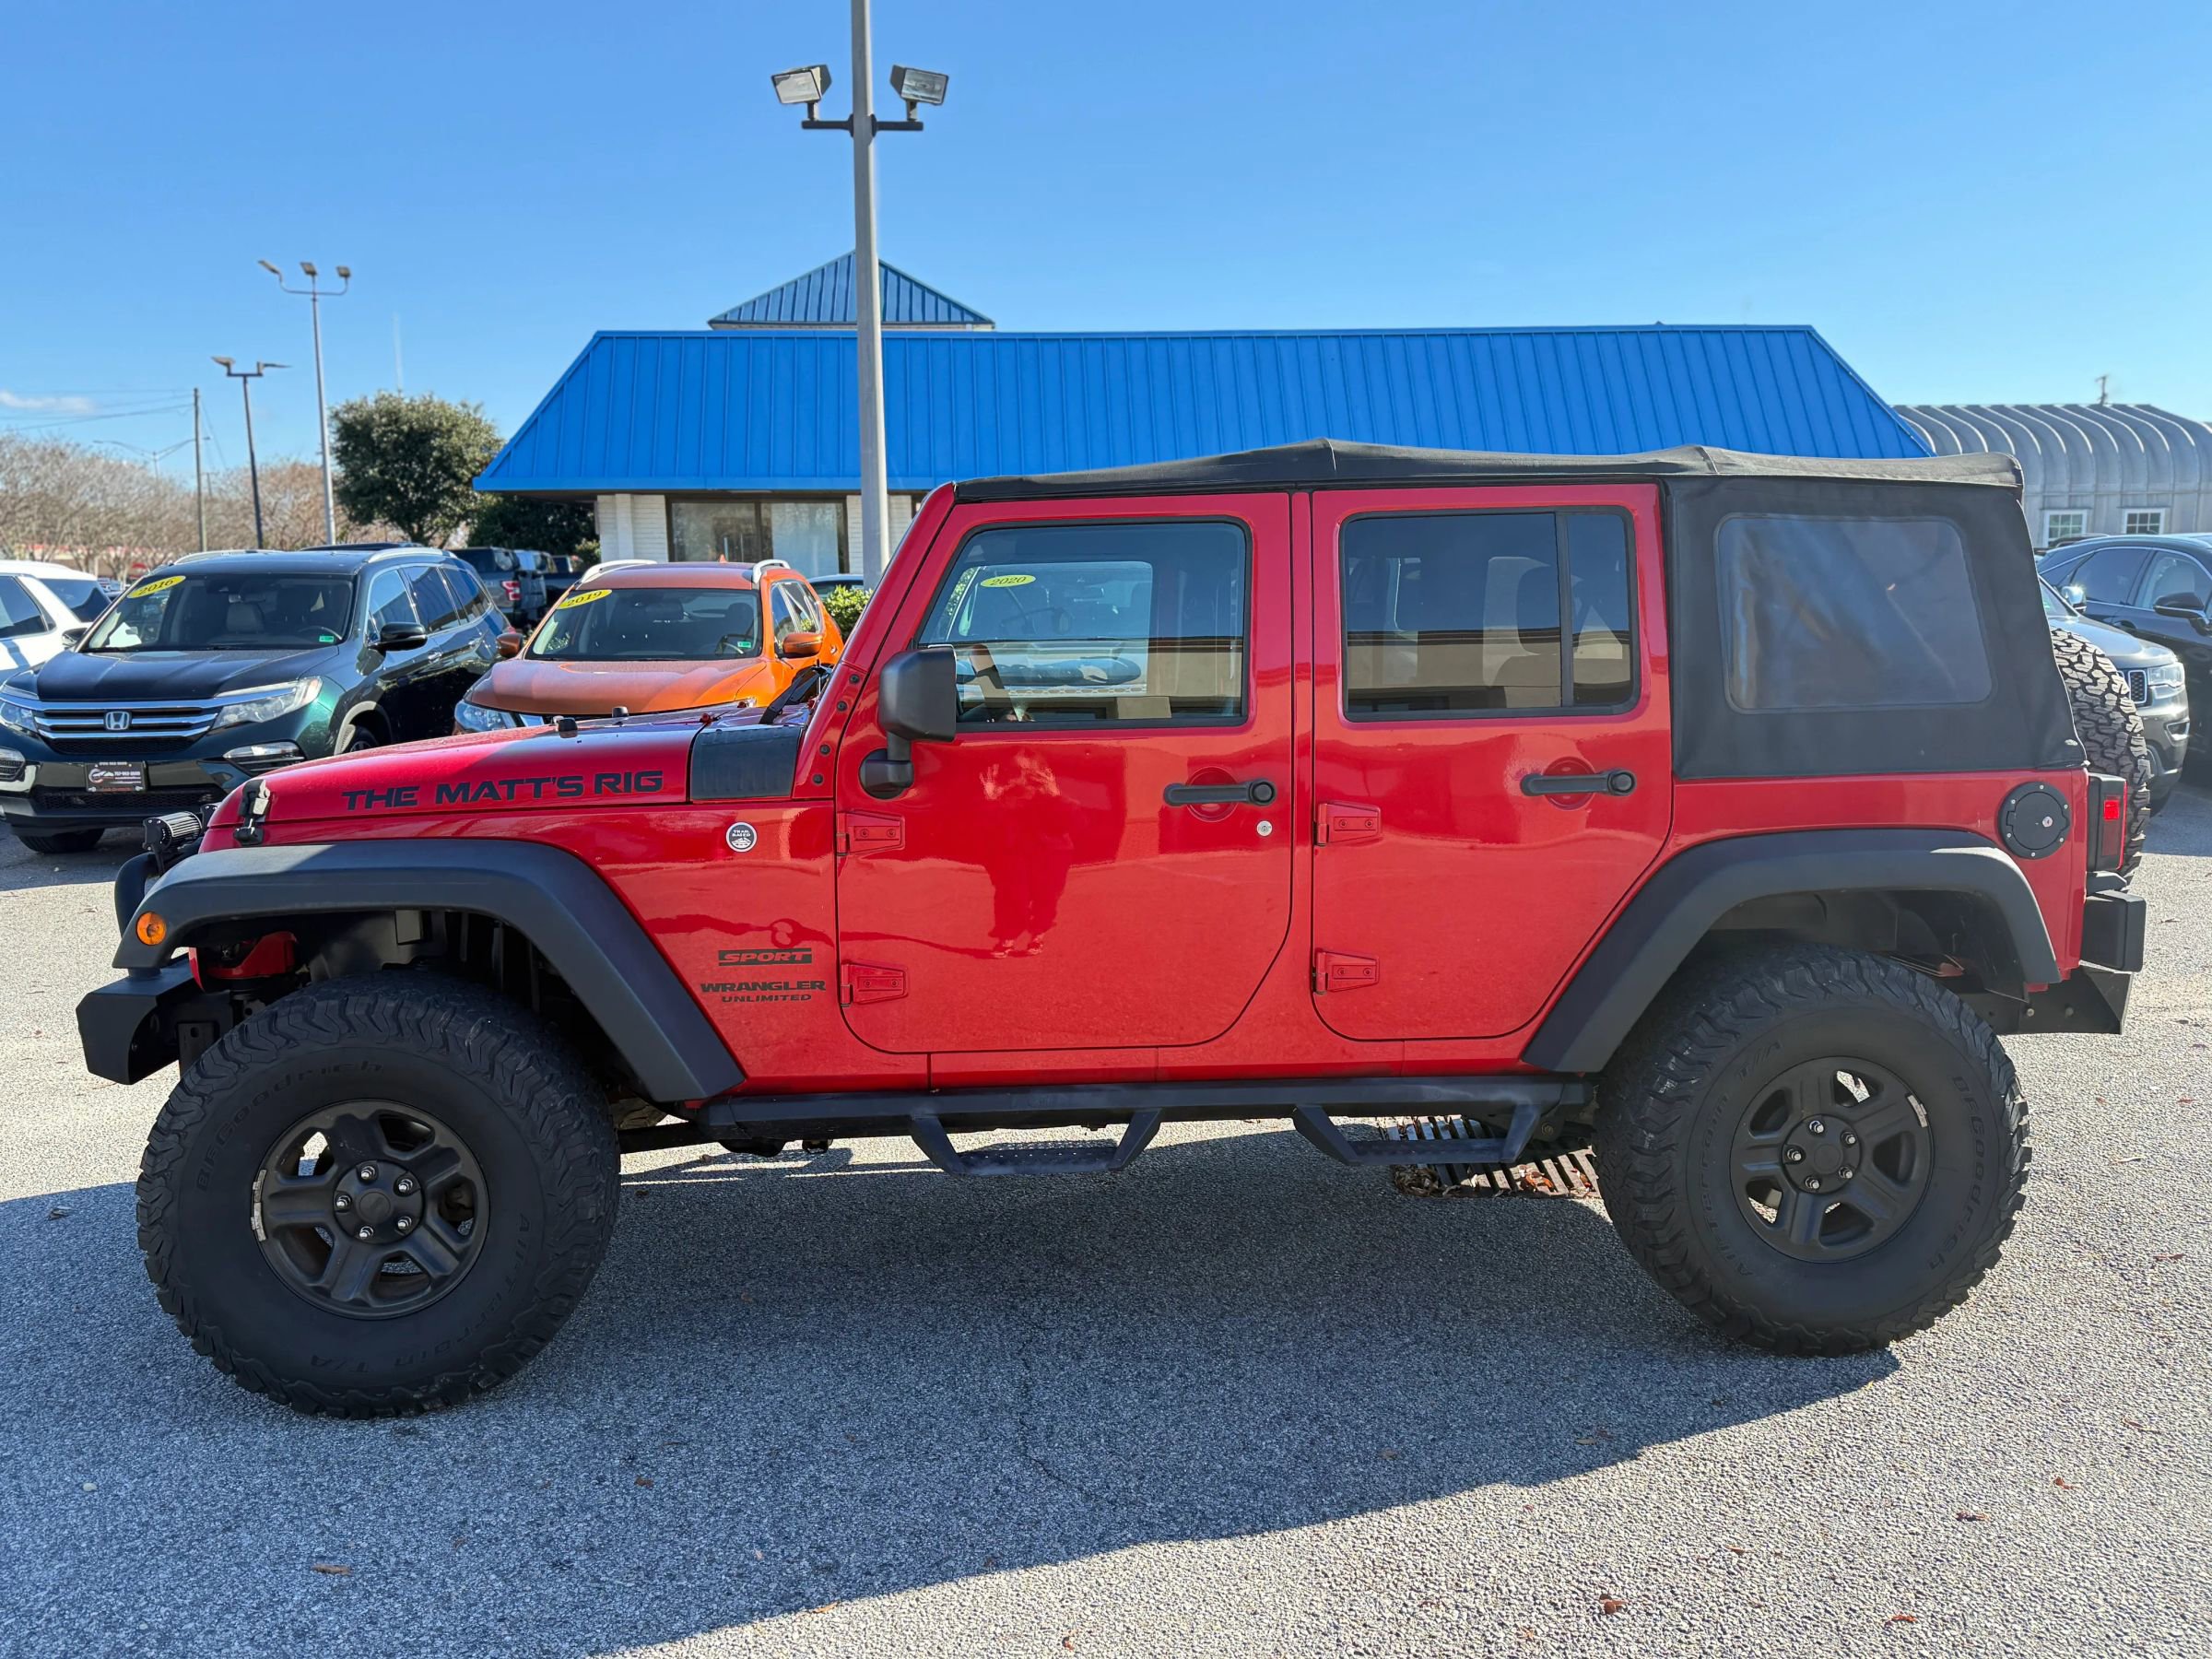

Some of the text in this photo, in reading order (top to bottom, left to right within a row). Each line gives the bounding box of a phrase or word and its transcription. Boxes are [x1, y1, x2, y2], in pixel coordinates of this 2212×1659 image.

[138, 580, 173, 595] 2016
[989, 576, 1027, 586] 2020
[342, 771, 663, 810] THE MATT'S RIG
[719, 950, 811, 964] SPORT
[700, 981, 826, 993] WRANGLER
[722, 994, 812, 1003] UNLIMITED
